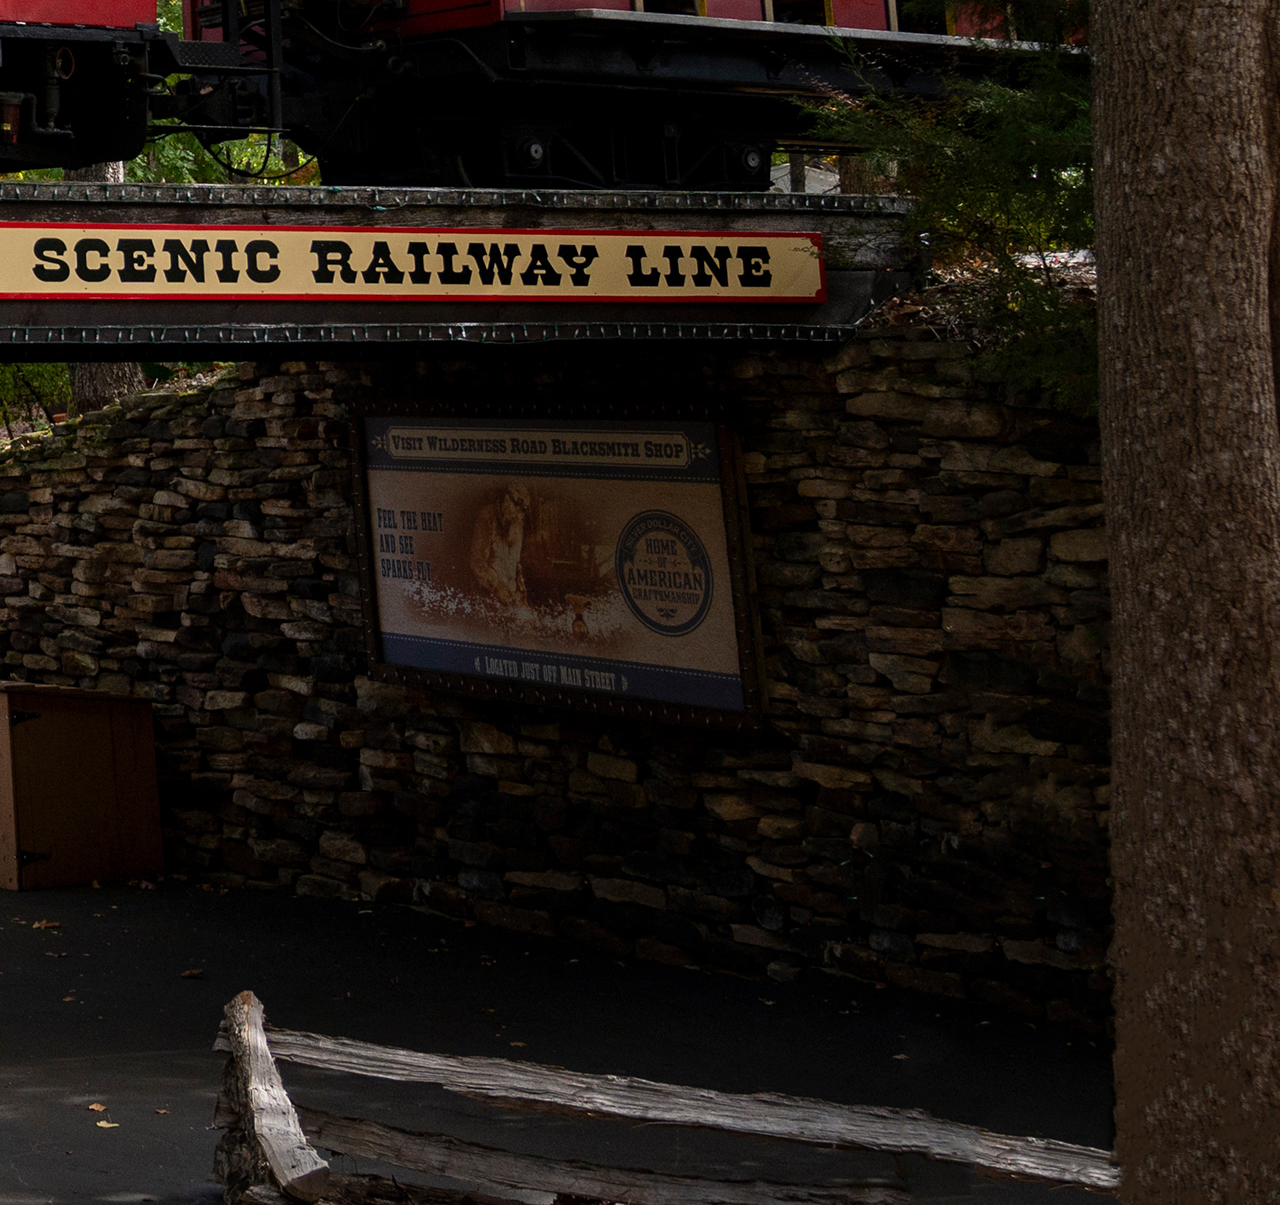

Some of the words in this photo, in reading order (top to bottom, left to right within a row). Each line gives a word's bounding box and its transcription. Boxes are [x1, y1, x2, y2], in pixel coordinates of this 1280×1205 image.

[32, 237, 281, 283] SCENIC
[309, 240, 599, 286] RAILWAY
[625, 244, 772, 287] LINE
[391, 435, 424, 451] VISIT
[426, 435, 507, 454] WILDERNESS
[510, 438, 547, 455] ROAD
[552, 438, 640, 458] BLACKSMITH
[644, 440, 684, 459] SHOP
[377, 507, 397, 529] FEEL
[400, 510, 418, 530] THE
[420, 511, 443, 532] HEAT
[380, 533, 396, 554] AND
[399, 535, 414, 555] SEE
[625, 522, 647, 548] SILVER
[646, 519, 680, 534] DOLLAR
[679, 531, 698, 553] CITY
[645, 538, 678, 555] HOME
[381, 558, 413, 579] SPARKS
[416, 561, 432, 581] FLY
[657, 557, 667, 568] OF
[627, 568, 704, 591] AMERICAN
[632, 587, 700, 605] CRAFTSMANSHIP
[485, 656, 519, 678] LOCATED
[520, 661, 540, 681] JUST
[543, 665, 557, 683] OFF
[560, 665, 582, 686] MAIN
[584, 669, 616, 691] STREET
